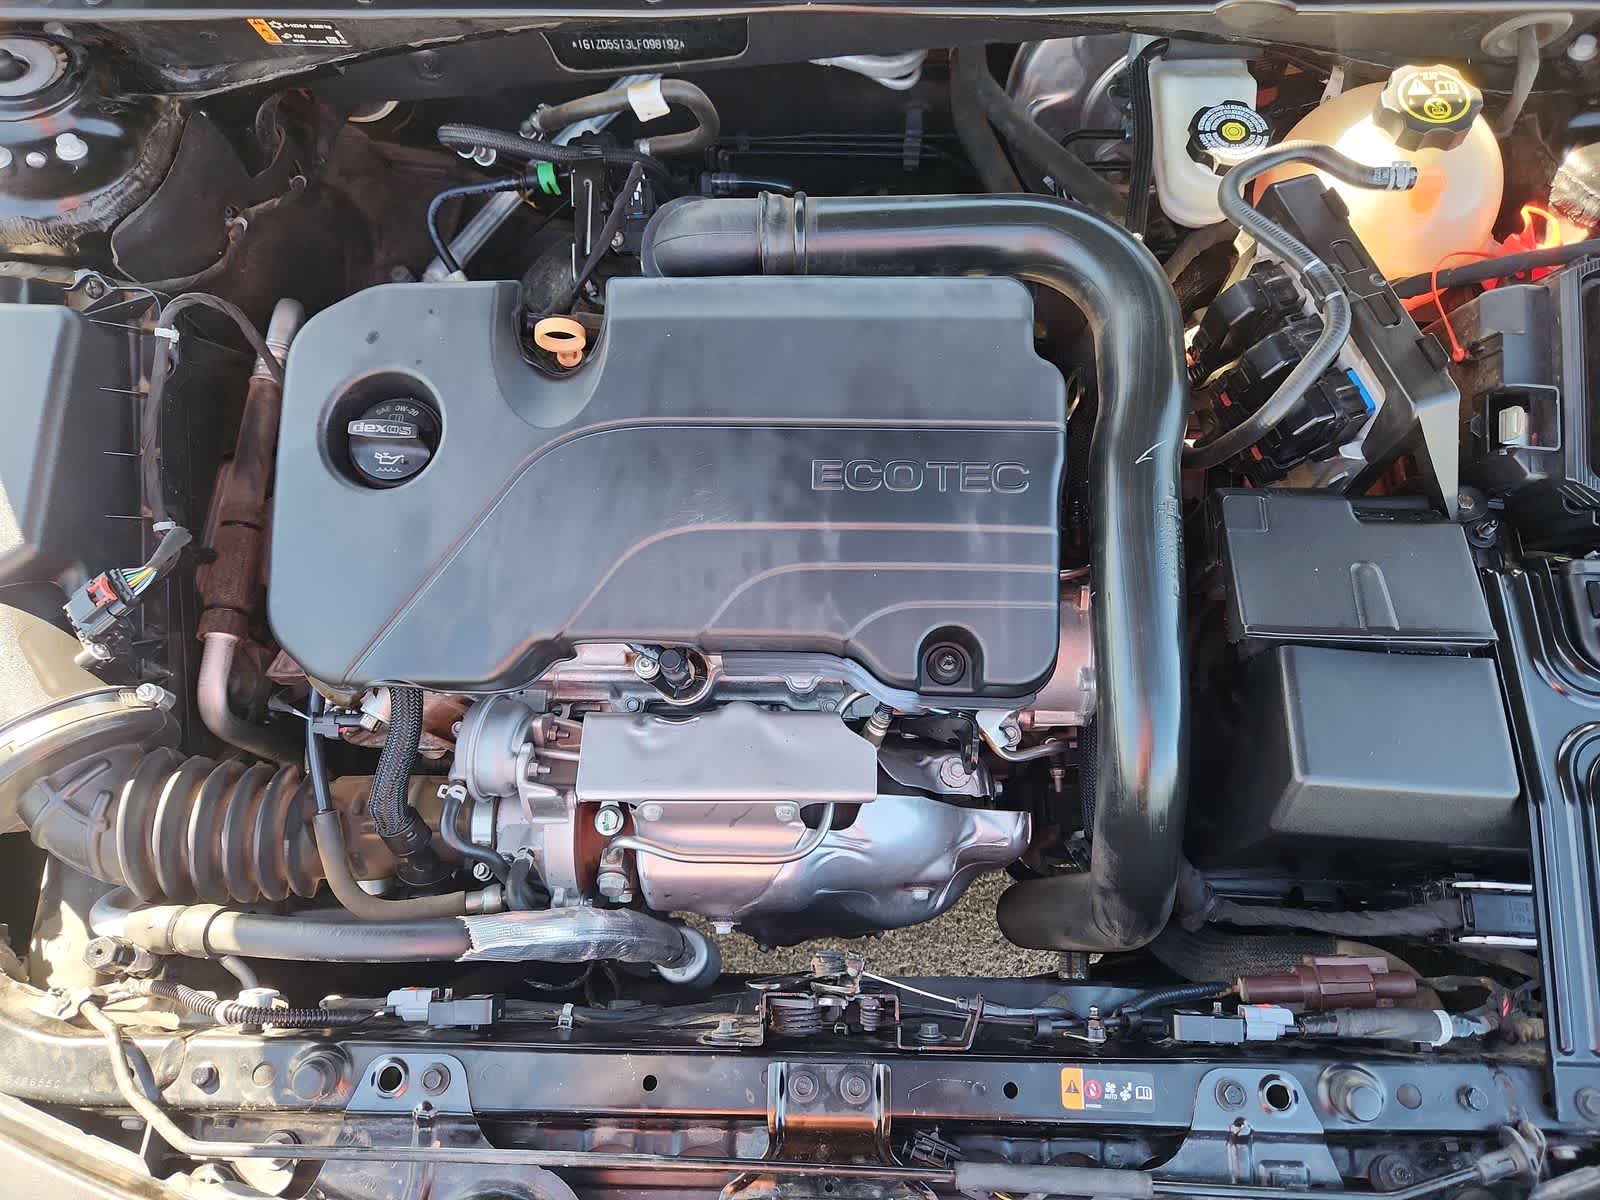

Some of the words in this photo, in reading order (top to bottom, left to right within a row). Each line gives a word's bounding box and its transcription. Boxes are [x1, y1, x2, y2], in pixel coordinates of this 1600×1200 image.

[395, 404, 419, 417] 0W-20
[352, 422, 412, 436] dexos
[811, 459, 1031, 494] ECOTEC
